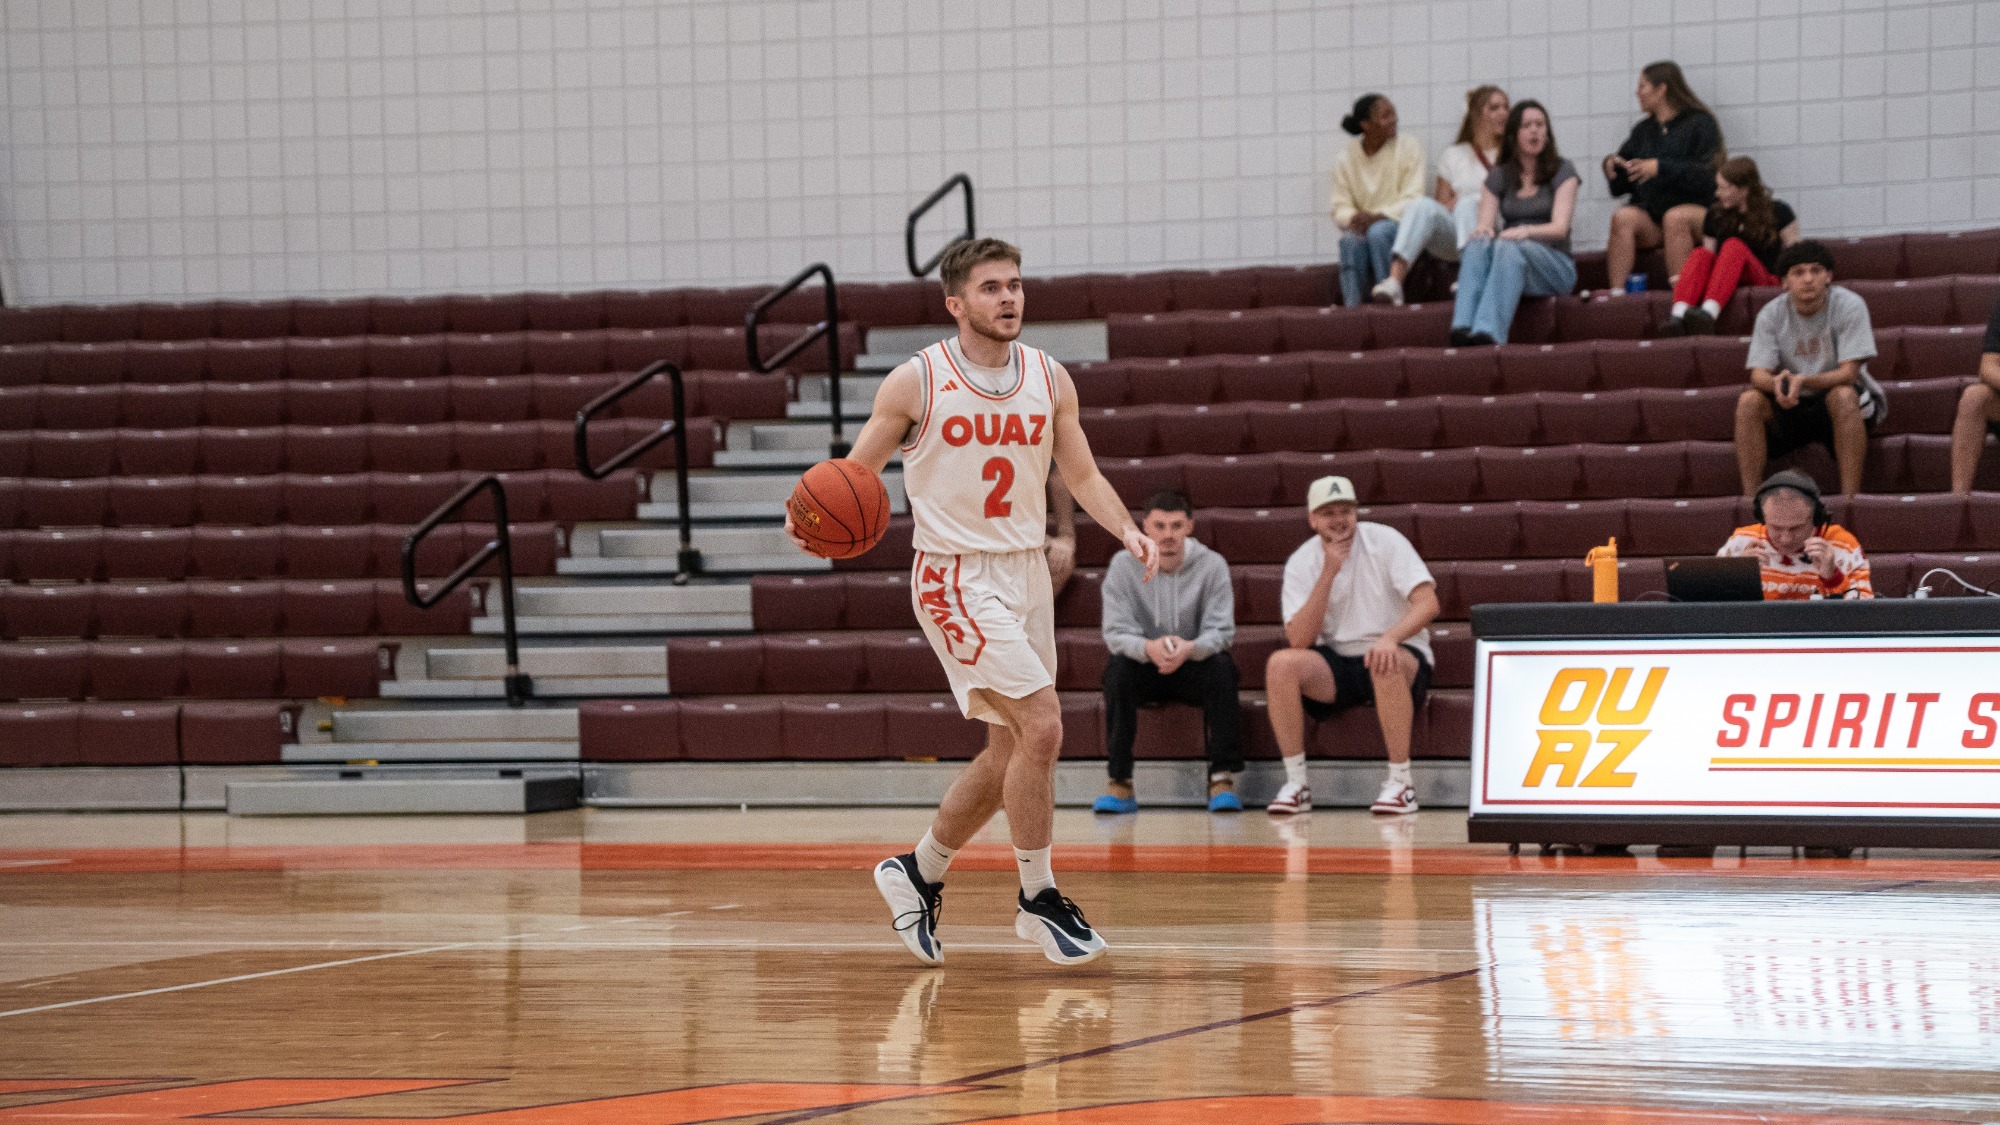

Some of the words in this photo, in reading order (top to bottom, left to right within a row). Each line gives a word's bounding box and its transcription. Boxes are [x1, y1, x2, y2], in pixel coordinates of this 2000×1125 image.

[941, 413, 1047, 447] OUAZ
[981, 456, 1015, 519] 2
[1328, 482, 1343, 496] A
[1539, 666, 1670, 726] OU
[1716, 692, 1941, 749] SPIRIT
[1522, 729, 1653, 788] AZ
